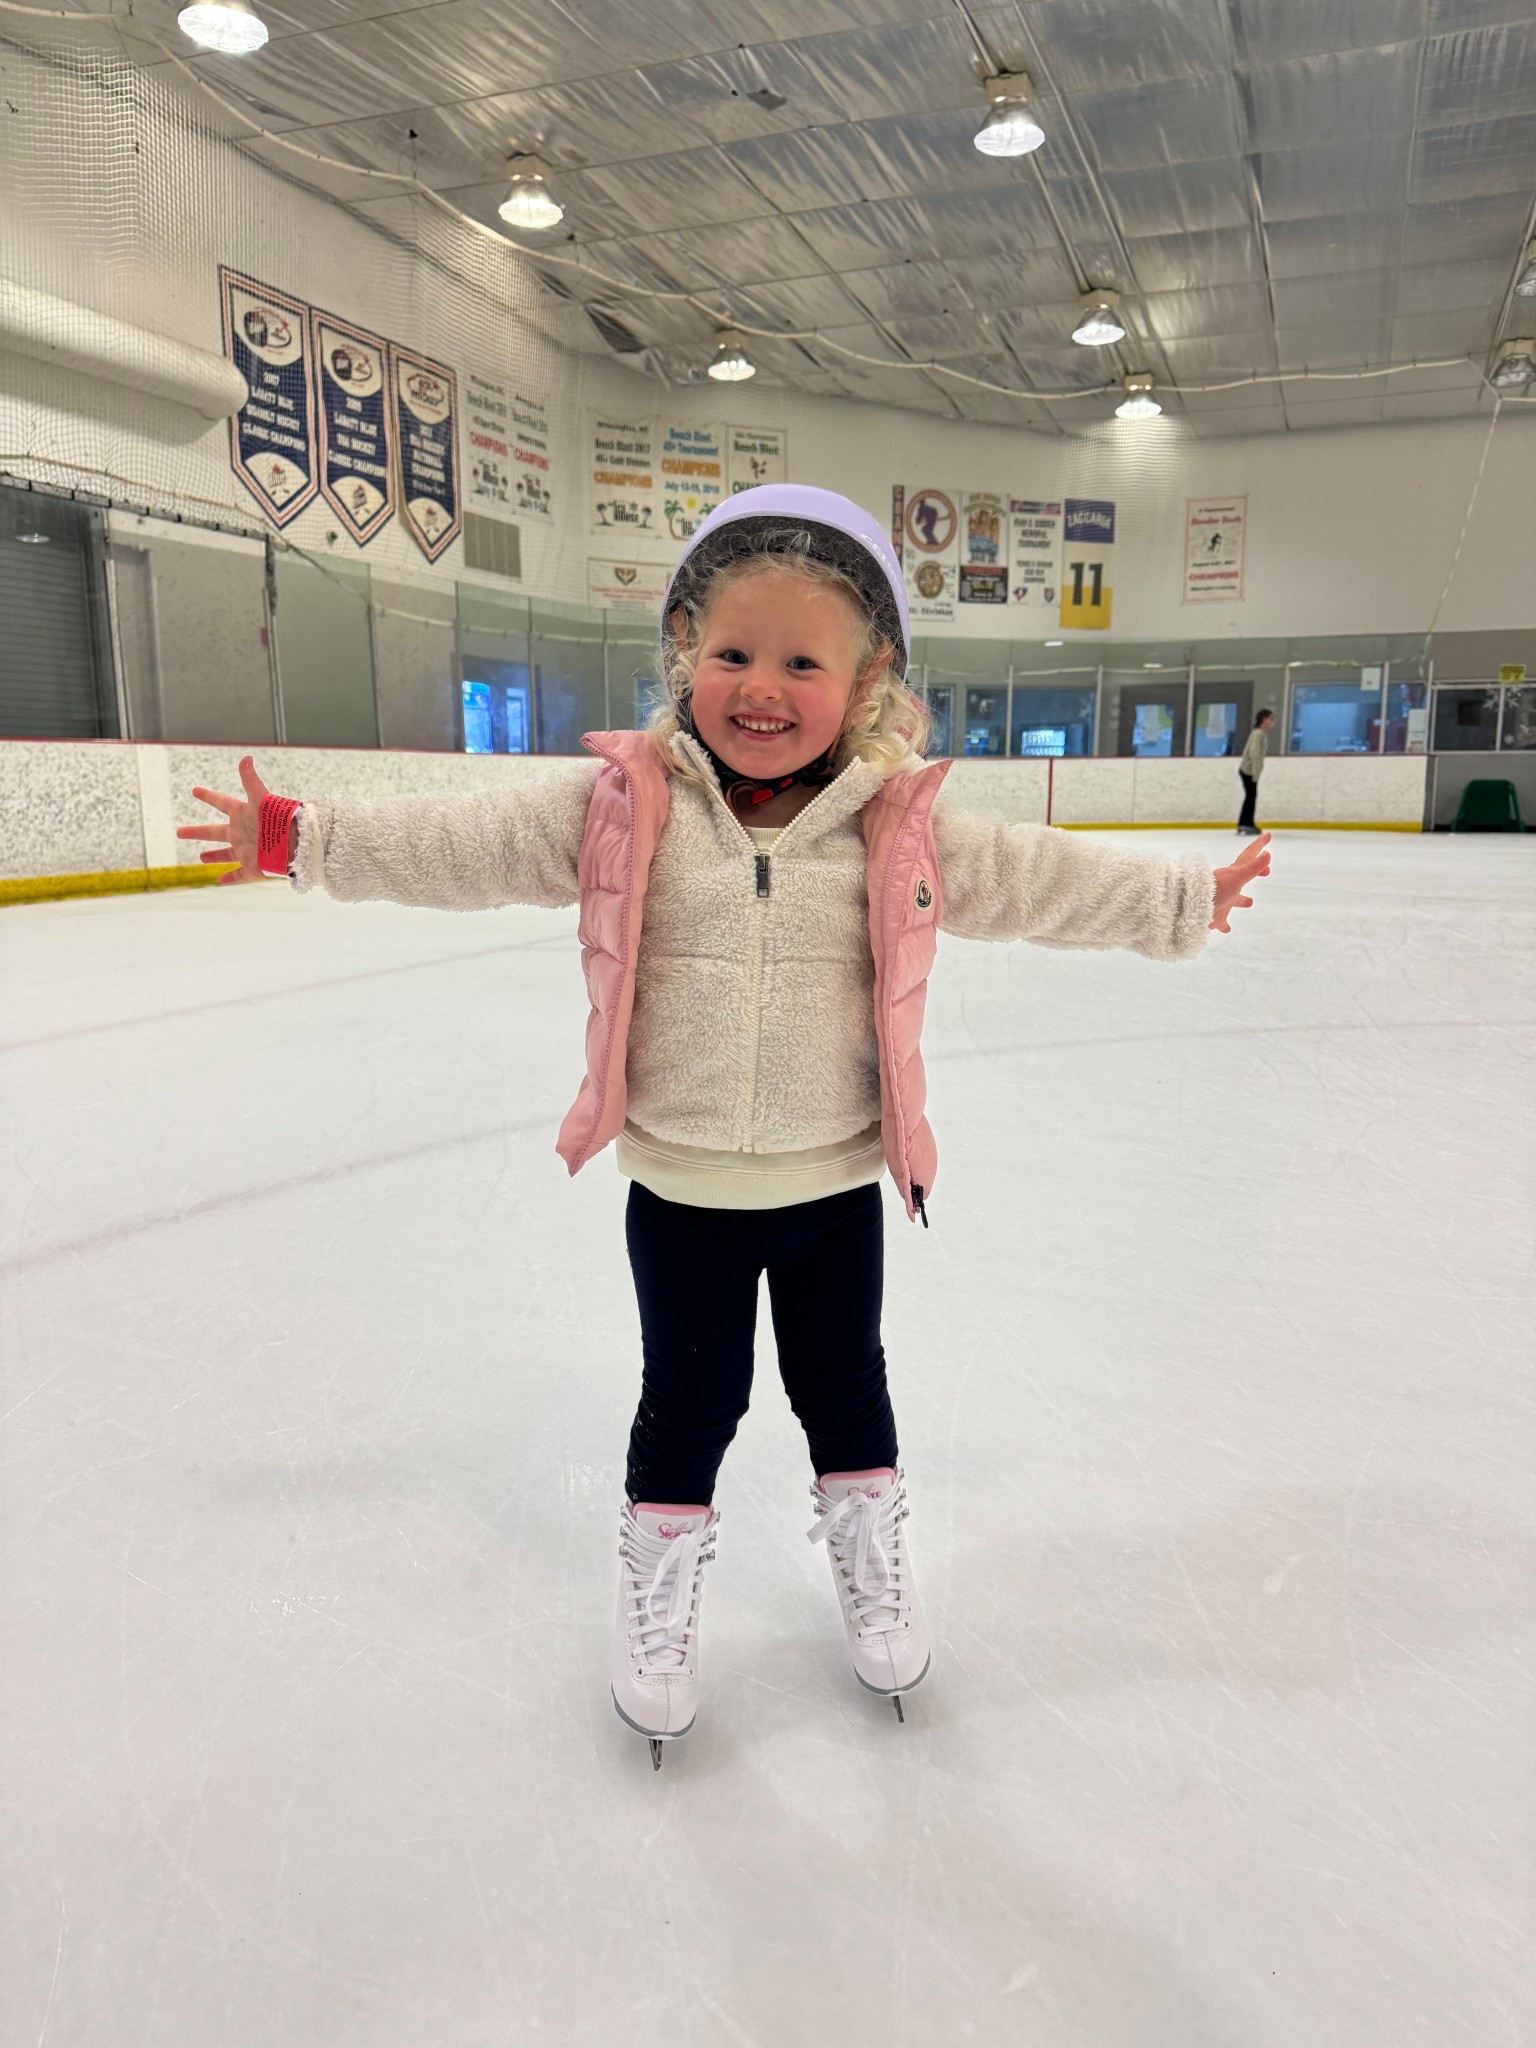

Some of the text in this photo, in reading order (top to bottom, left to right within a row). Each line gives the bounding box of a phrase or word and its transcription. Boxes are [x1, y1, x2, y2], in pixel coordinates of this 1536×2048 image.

[669, 428, 691, 441] Beach
[661, 458, 721, 478] CHAMPIONS
[593, 471, 653, 489] CHAMPIONS
[1070, 562, 1103, 606] 11
[1188, 570, 1240, 581] CHAMPIONS
